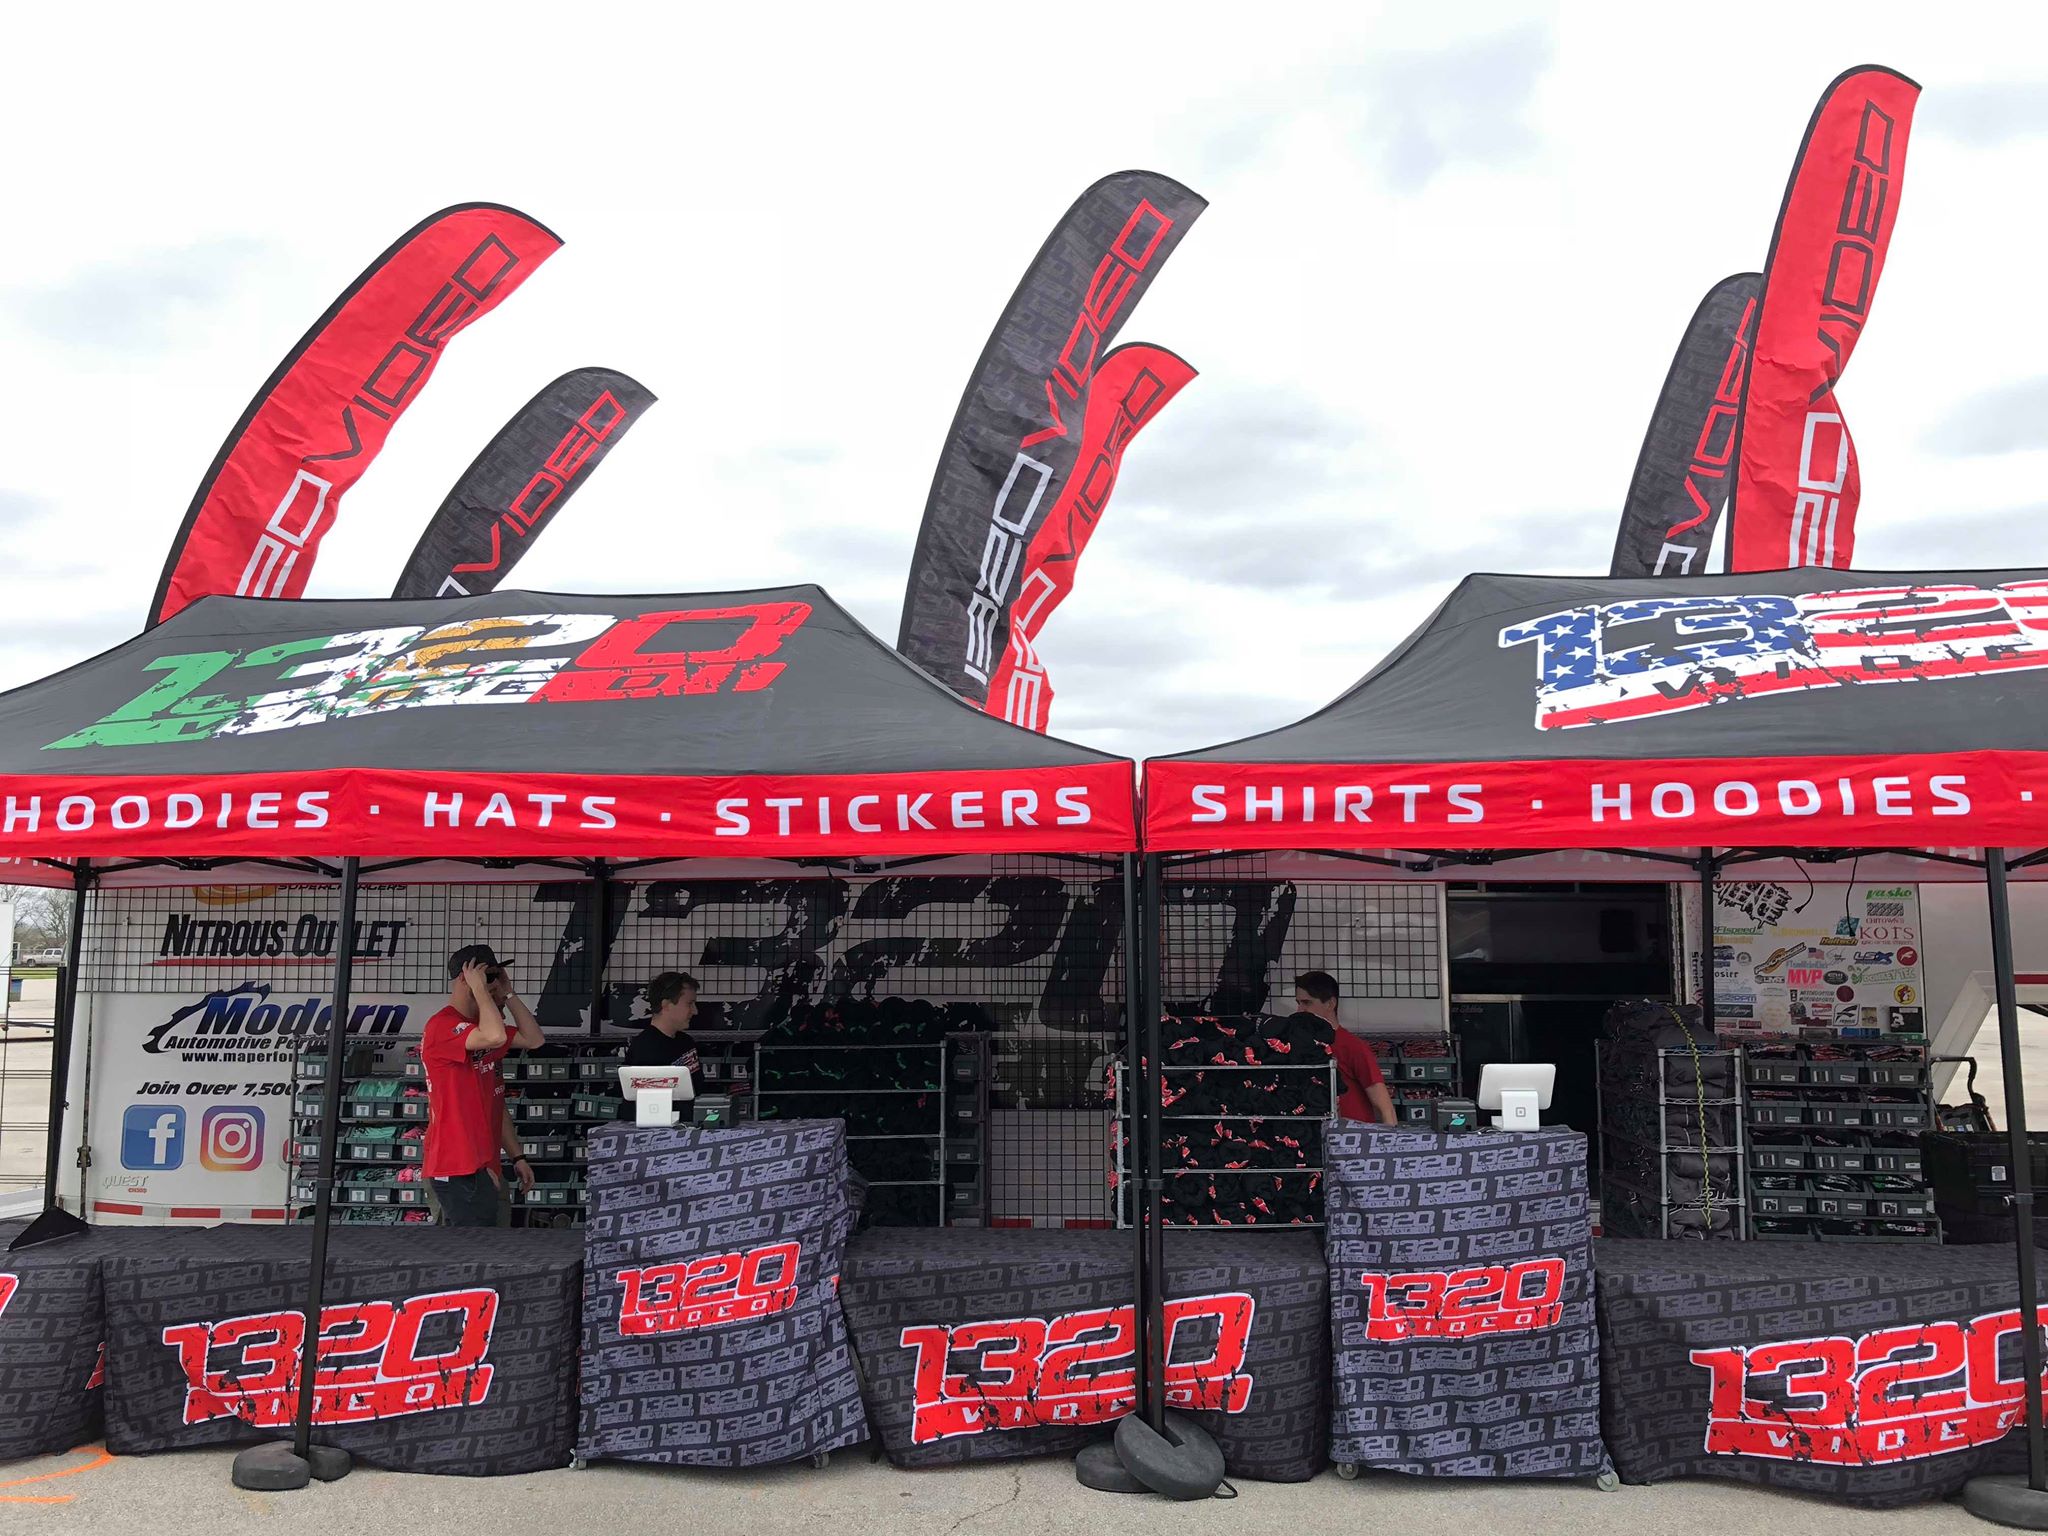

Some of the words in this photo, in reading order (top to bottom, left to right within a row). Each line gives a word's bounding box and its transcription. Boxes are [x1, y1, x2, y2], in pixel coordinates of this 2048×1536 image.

[2, 790, 330, 833] HOODIES
[423, 791, 617, 830] HATS
[715, 786, 1091, 837] STICKERS
[1191, 784, 1485, 824] SHIRTS
[1591, 775, 1972, 823] HOODIES
[160, 913, 288, 957] NITROUS
[291, 913, 408, 958] OULET
[1859, 926, 1915, 941] KOTS
[1787, 969, 1823, 985] MVP
[164, 1035, 272, 1050] Automotive
[136, 1081, 181, 1095] Join
[186, 1082, 238, 1096] Over
[616, 1242, 801, 1316] 1320
[1361, 1257, 1565, 1320] 1320
[645, 1299, 768, 1330] VIDEO
[1395, 1312, 1533, 1334] VIDEO
[162, 1287, 499, 1394] 1320
[900, 1292, 1256, 1406] 1320
